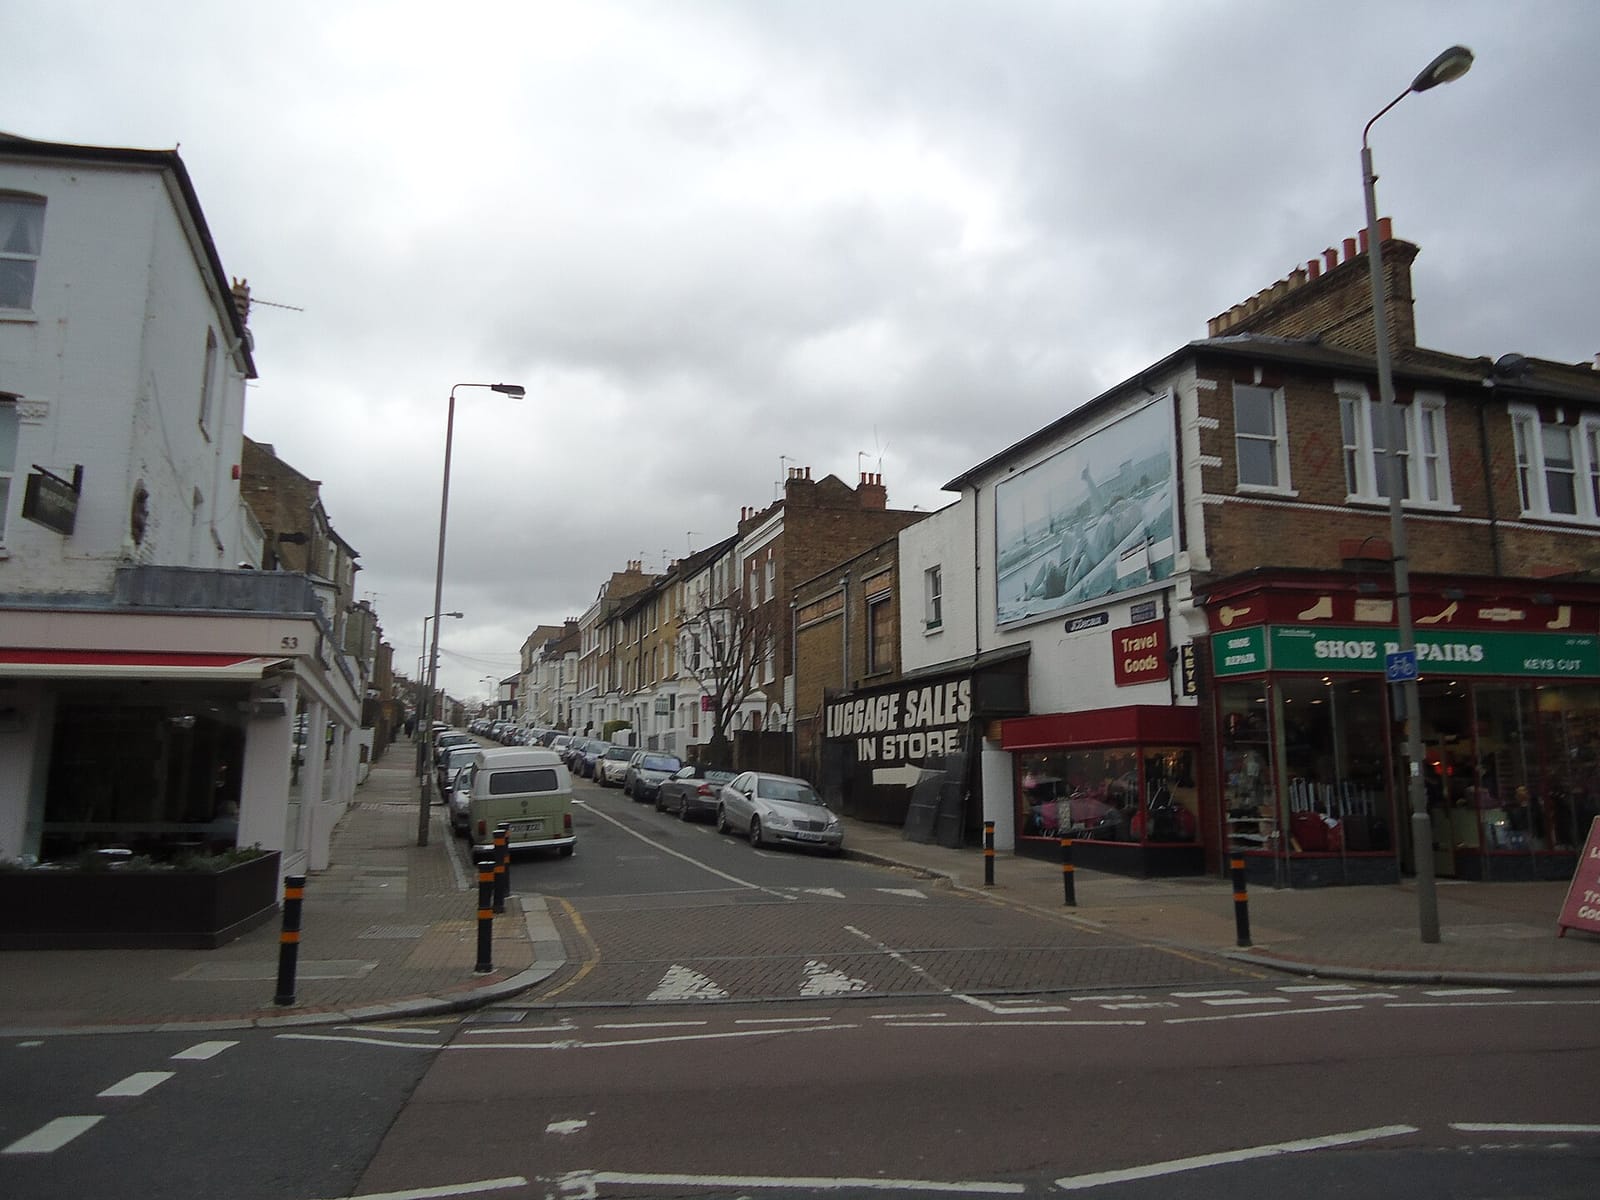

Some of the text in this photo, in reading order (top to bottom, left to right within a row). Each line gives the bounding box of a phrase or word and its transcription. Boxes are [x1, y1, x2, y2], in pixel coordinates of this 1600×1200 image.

[281, 636, 298, 649] 53
[1121, 632, 1158, 653] Travel
[1227, 637, 1251, 649] SHOE
[1314, 640, 1483, 662] SHOE RPAIRS
[1124, 655, 1158, 674] Goods
[1184, 646, 1196, 693] KEYS
[1524, 659, 1581, 671] KEYS CUT
[826, 679, 971, 738] LUGGAGE SALES
[857, 729, 959, 762] IN STORE
